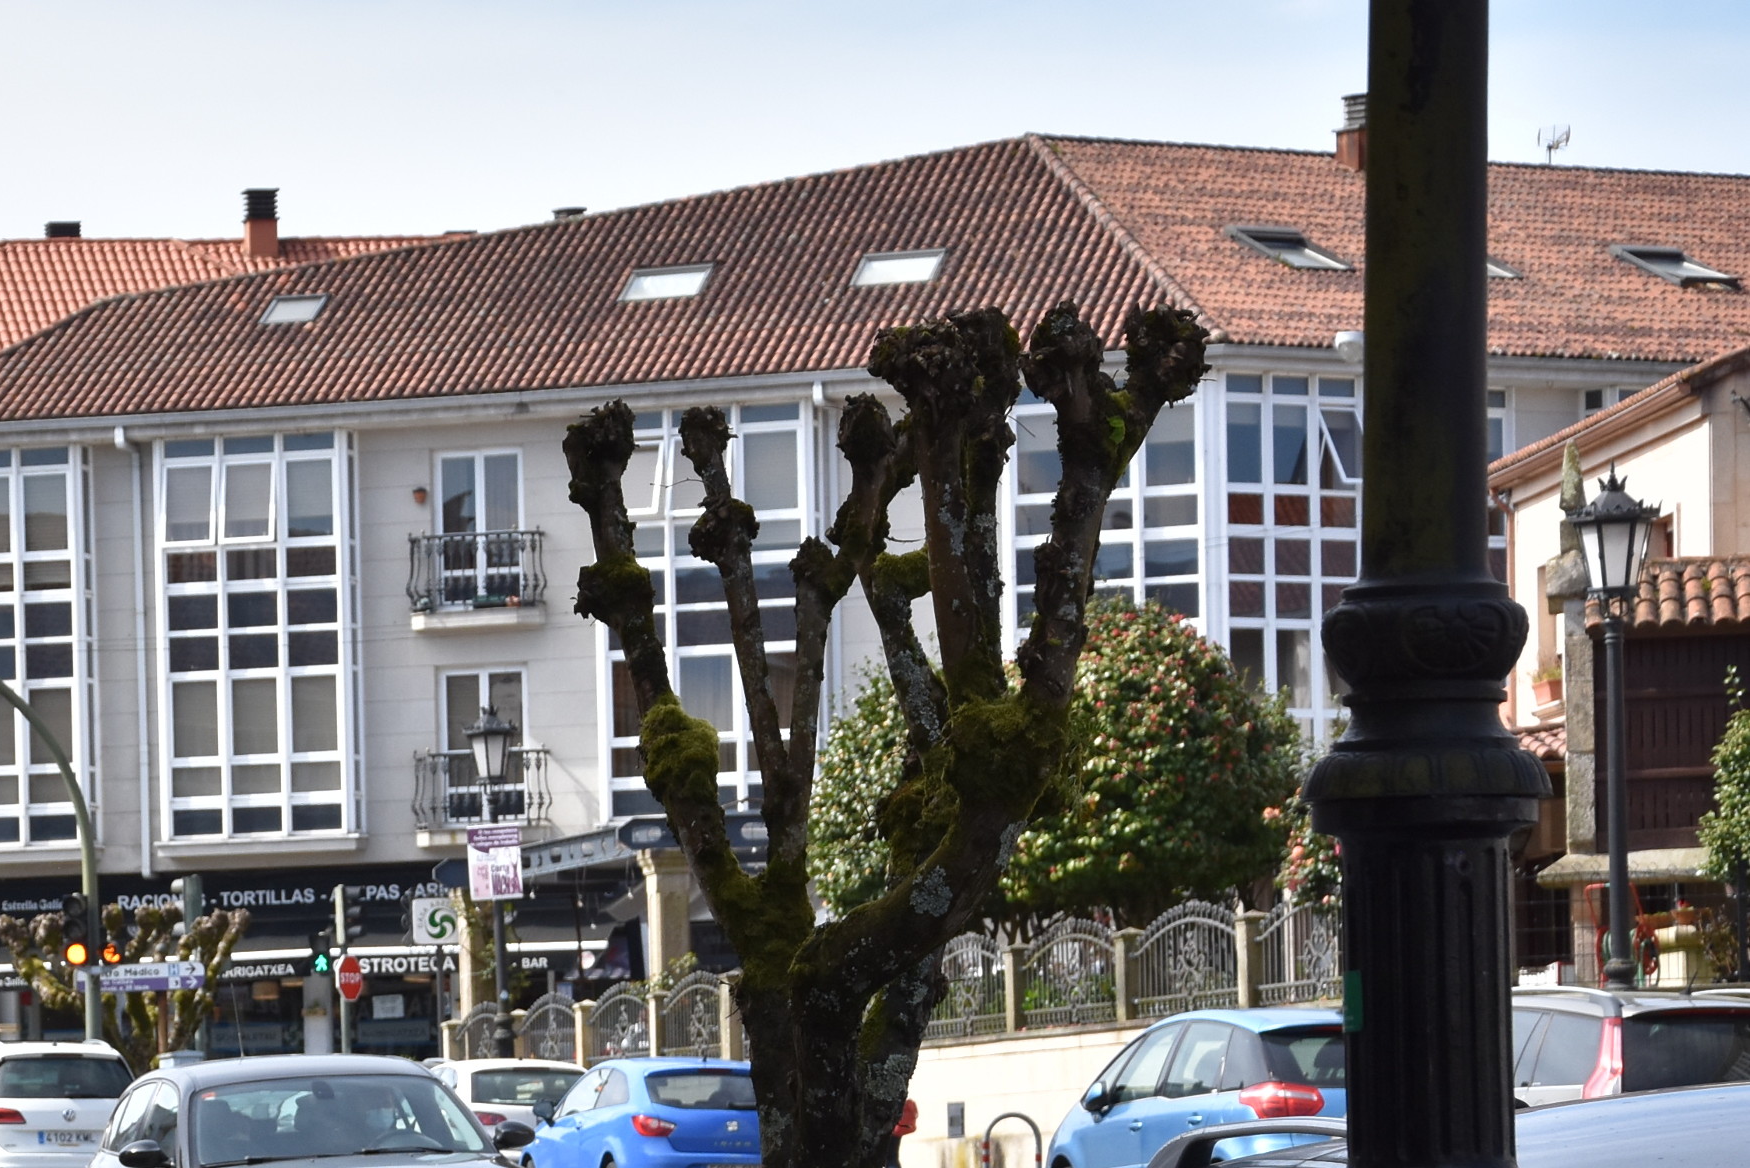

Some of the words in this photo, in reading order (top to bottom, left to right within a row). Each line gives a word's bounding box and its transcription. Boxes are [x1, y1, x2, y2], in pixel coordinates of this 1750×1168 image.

[219, 888, 315, 906] TORTILLAS
[521, 957, 548, 969] BAR
[340, 972, 363, 984] STOP
